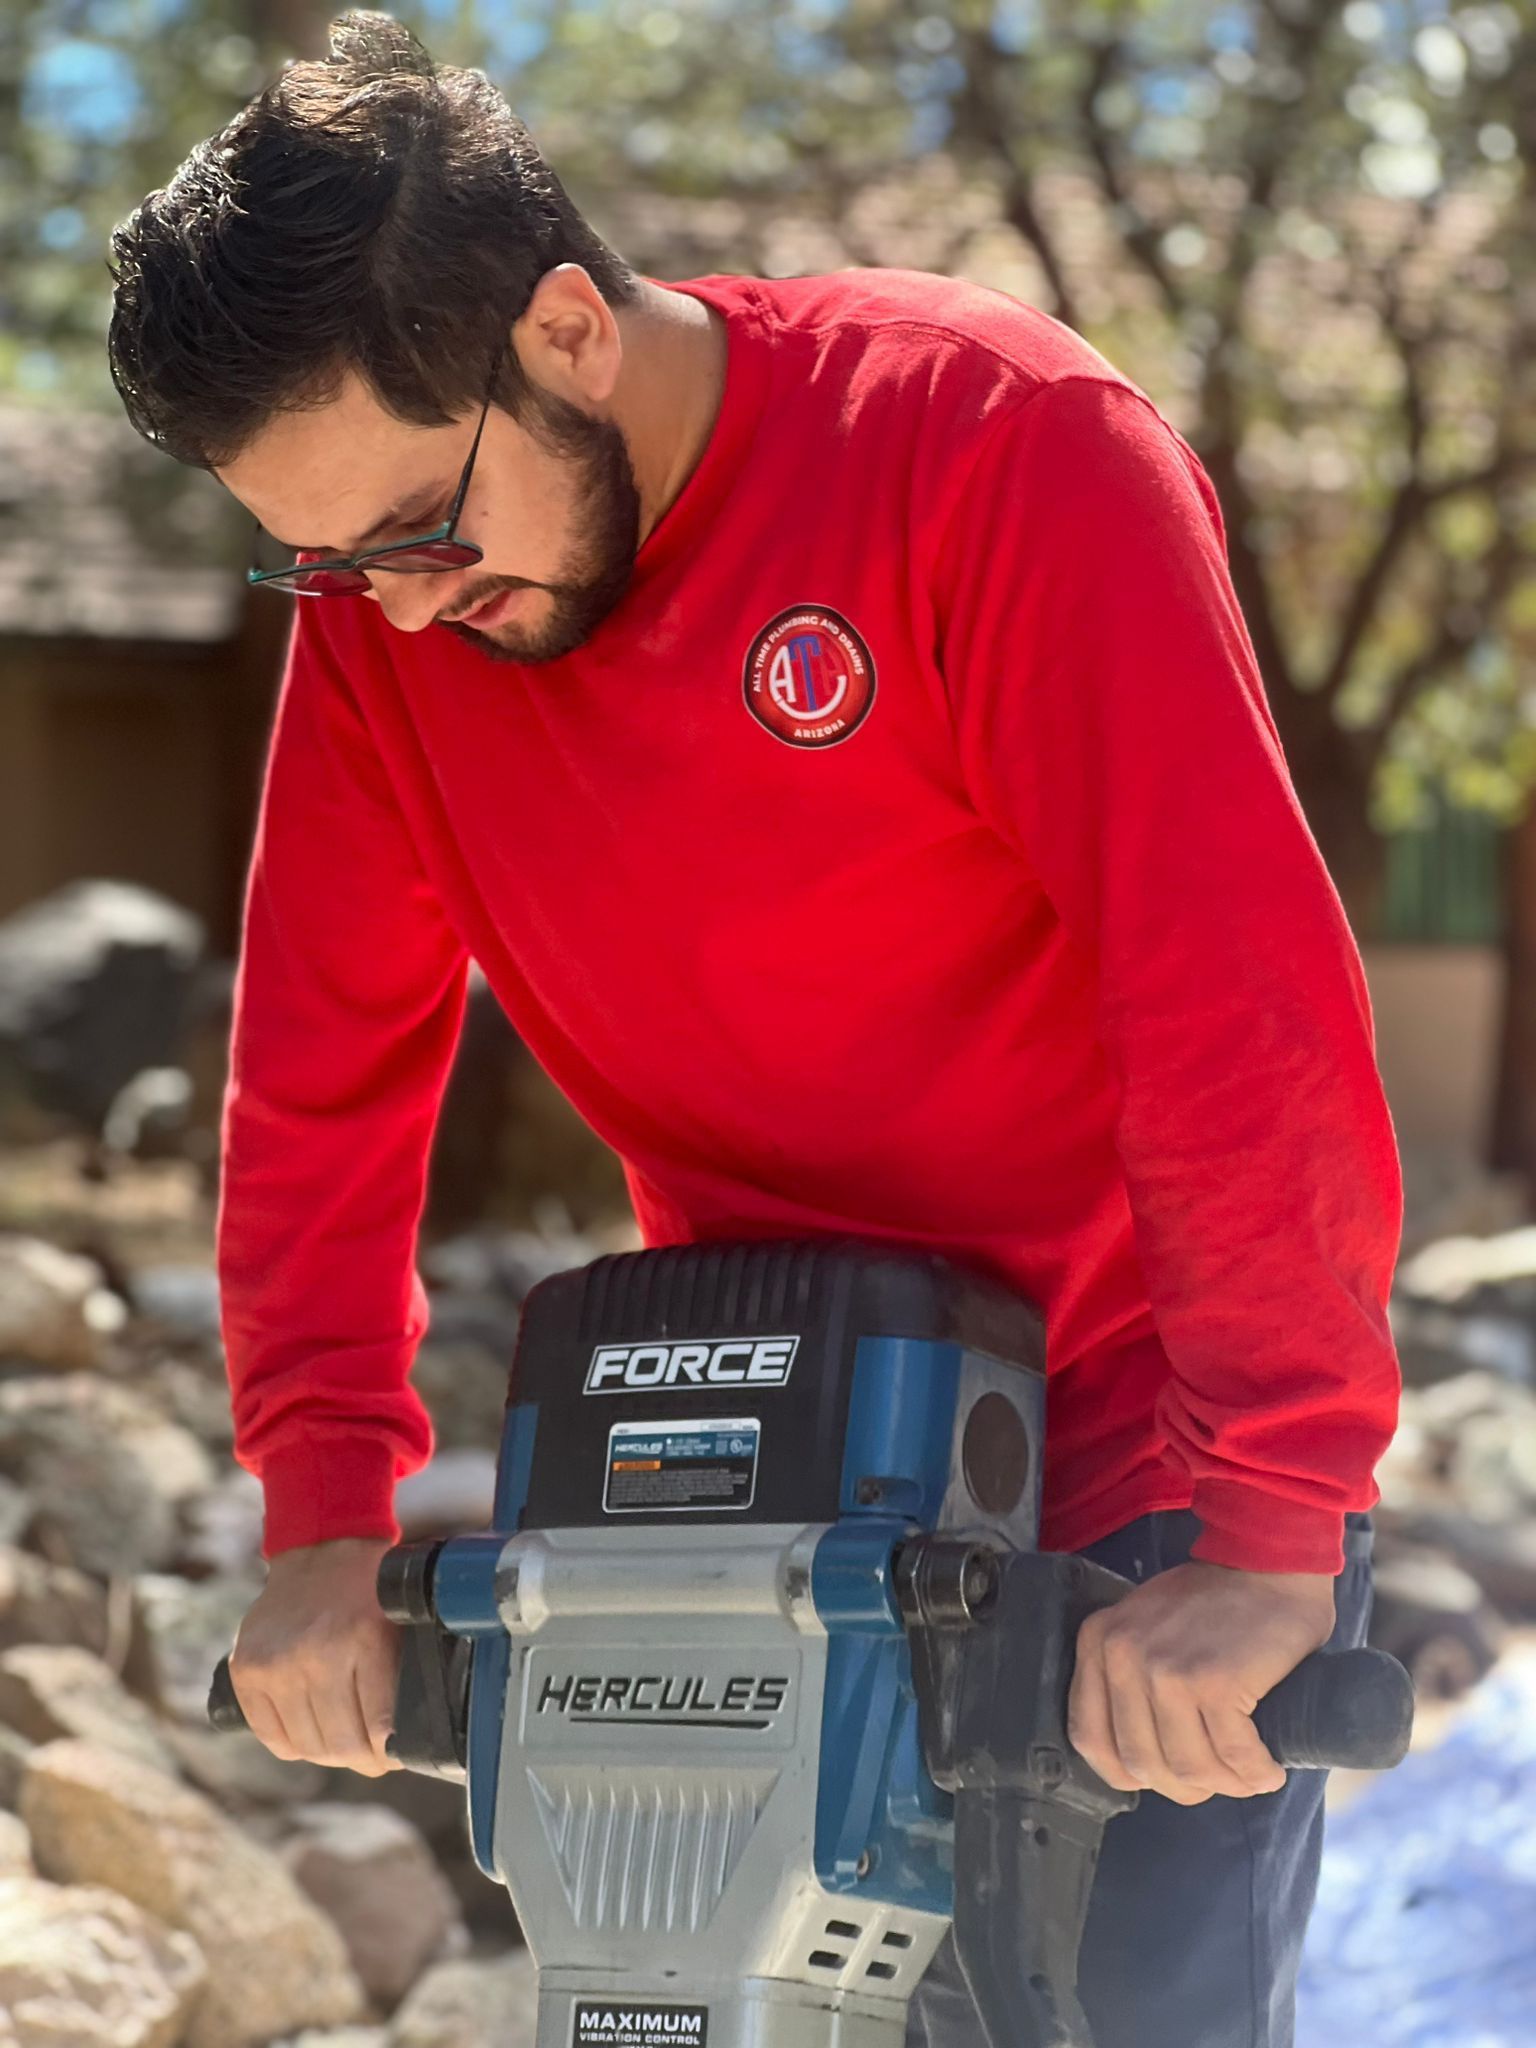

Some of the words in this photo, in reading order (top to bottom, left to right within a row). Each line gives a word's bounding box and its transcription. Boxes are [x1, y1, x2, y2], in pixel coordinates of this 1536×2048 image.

[768, 616, 819, 643] PLUMBING
[820, 618, 839, 635] AND
[755, 642, 771, 669] TIME
[838, 633, 864, 675] DRAINS
[753, 671, 762, 692] ALL
[794, 719, 846, 738] ARIZONA
[589, 1342, 793, 1388] FORCE
[537, 1675, 790, 1713] HERCULES
[580, 2012, 702, 2032] MAXIMUM
[579, 2032, 641, 2043] VIBRATION
[645, 2034, 700, 2046] CONTROL
